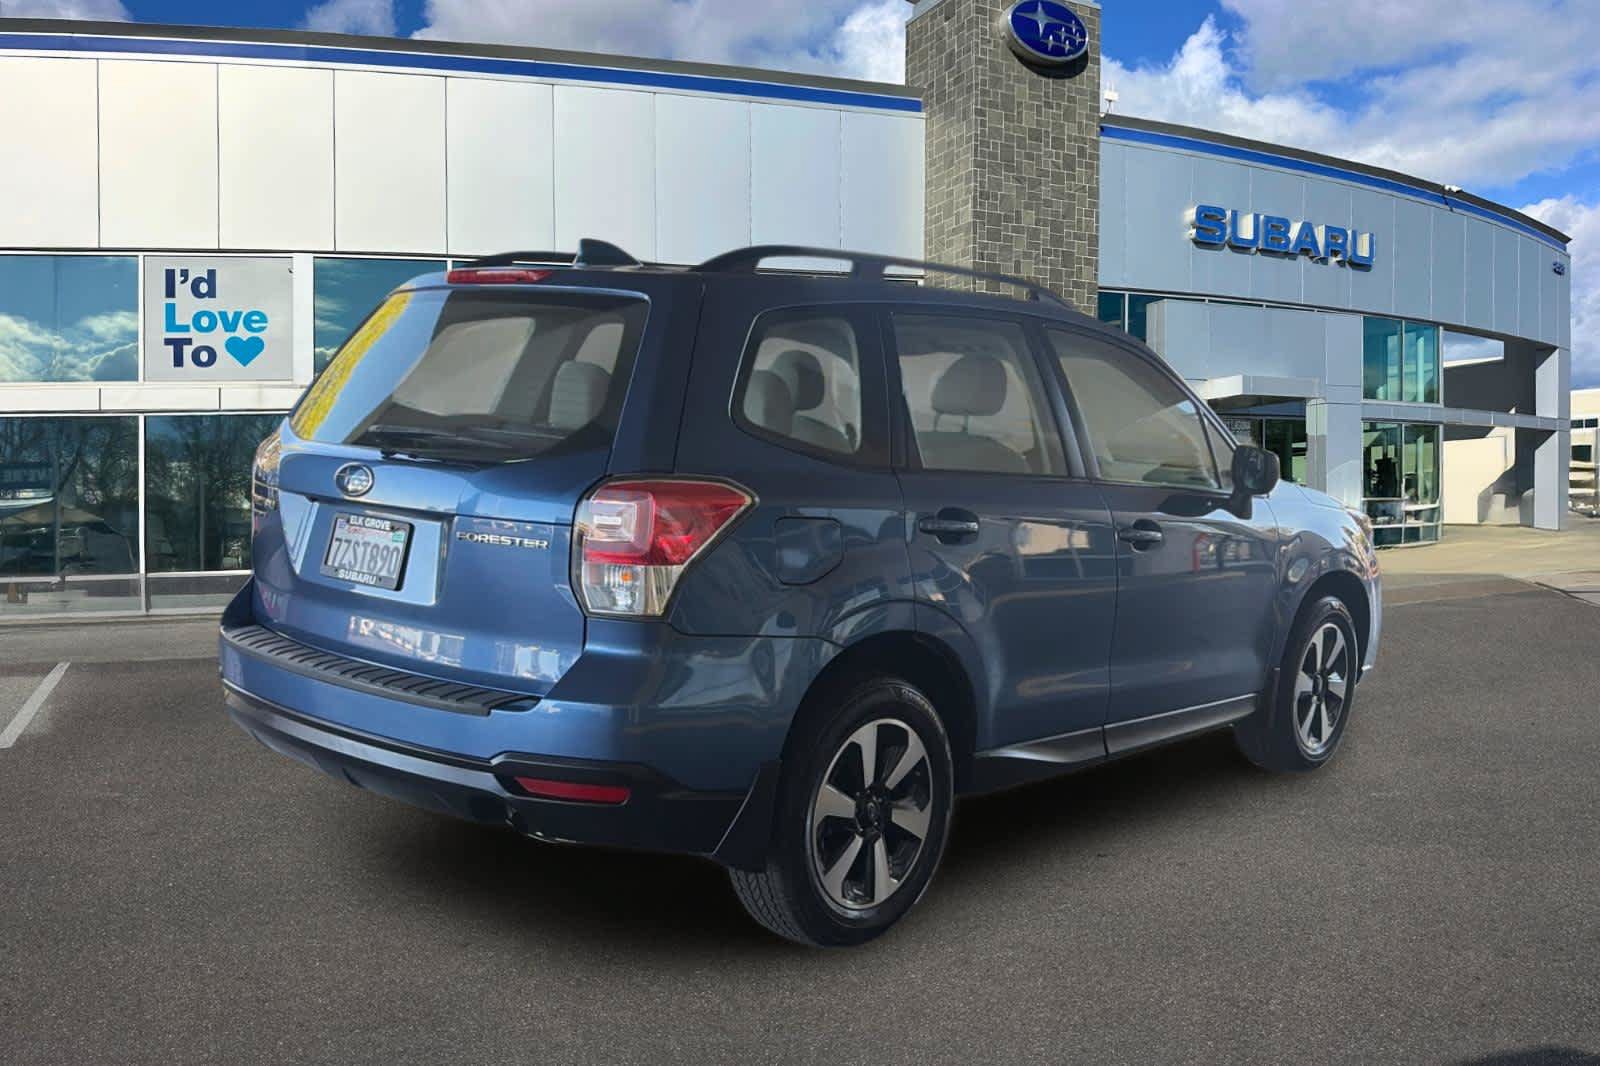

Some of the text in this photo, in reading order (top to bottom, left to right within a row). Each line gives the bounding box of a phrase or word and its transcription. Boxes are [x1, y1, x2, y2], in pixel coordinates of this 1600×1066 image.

[1189, 204, 1376, 271] SUBARU
[165, 268, 217, 299] I'd
[165, 302, 268, 333] Love
[164, 337, 217, 368] To
[349, 515, 392, 530] ELK GROVE
[456, 531, 550, 550] FORESTER
[332, 537, 400, 576] 7ZST890
[338, 569, 377, 585] SUBARU
